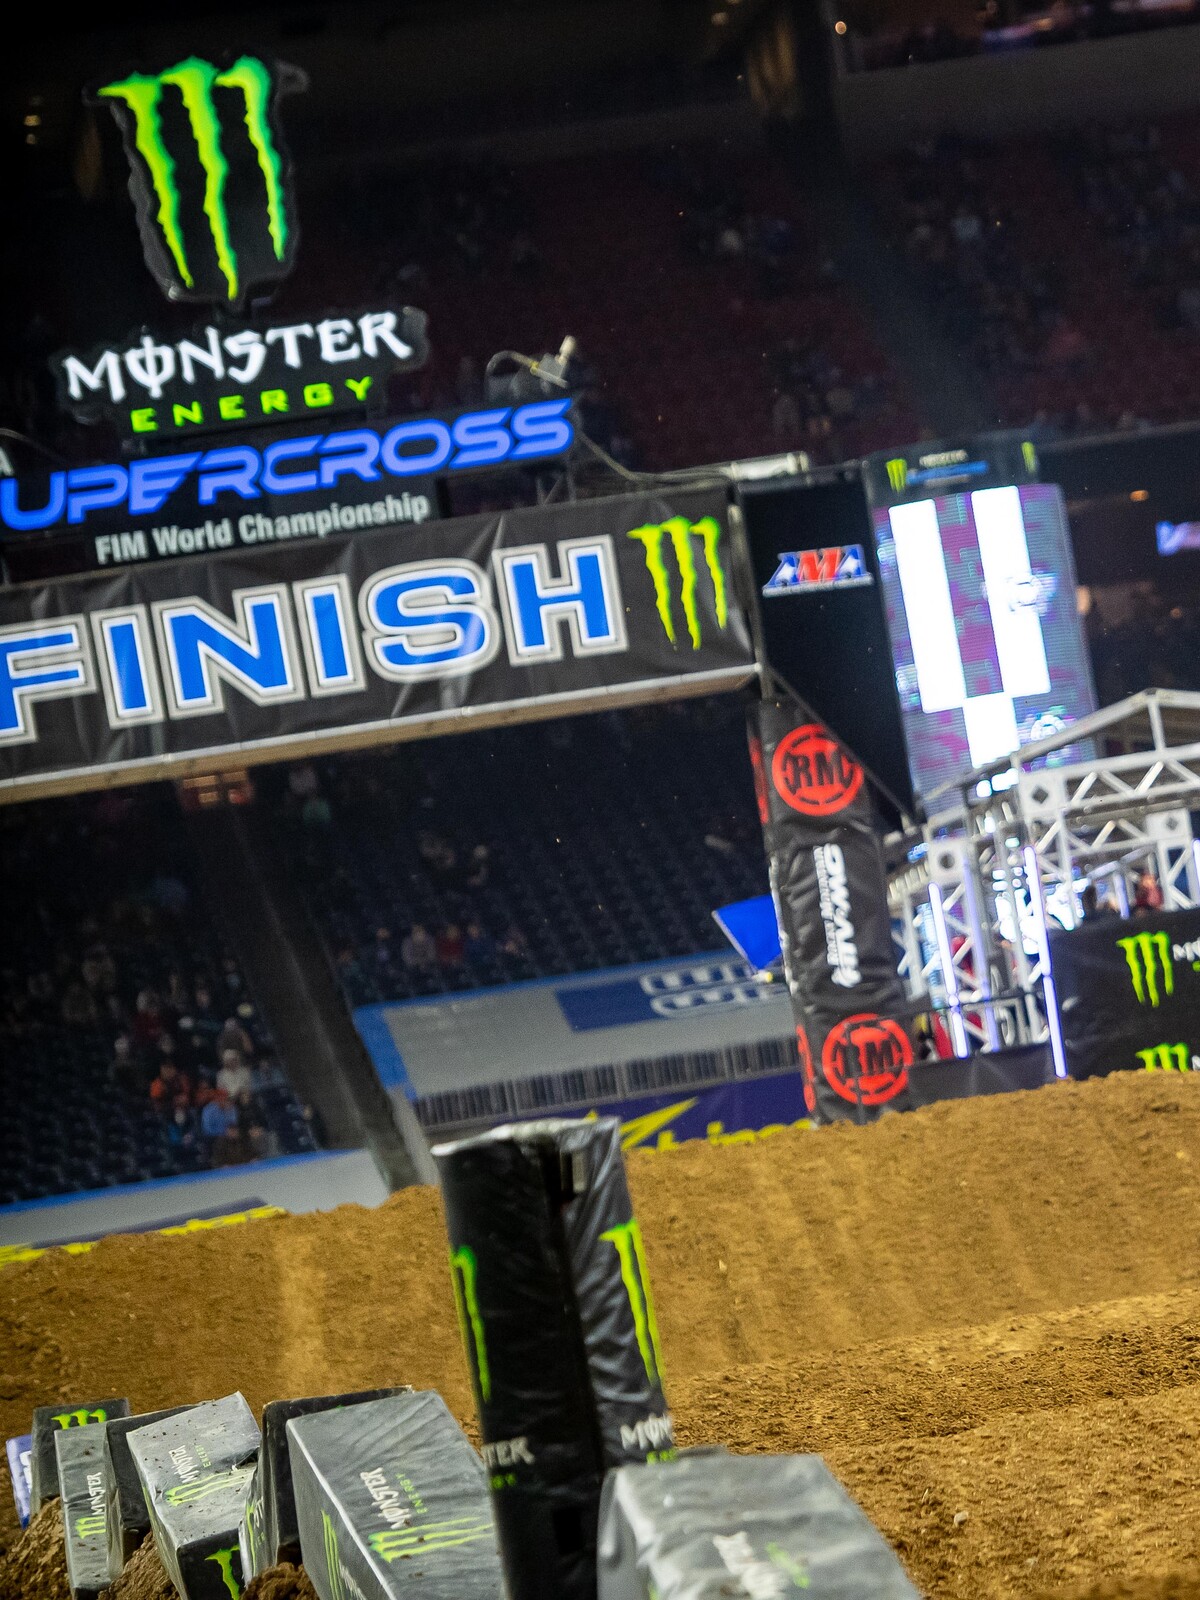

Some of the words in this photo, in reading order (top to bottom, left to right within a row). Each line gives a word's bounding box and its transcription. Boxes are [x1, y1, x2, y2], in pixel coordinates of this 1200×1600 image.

[63, 308, 413, 402] MONSTER
[131, 375, 374, 433] ENERGY
[95, 534, 146, 564] FIM
[152, 522, 234, 557] World
[242, 493, 430, 545] Championship
[763, 545, 868, 590] AMA
[0, 534, 628, 747] FINISH
[360, 1467, 412, 1529] MONSTER
